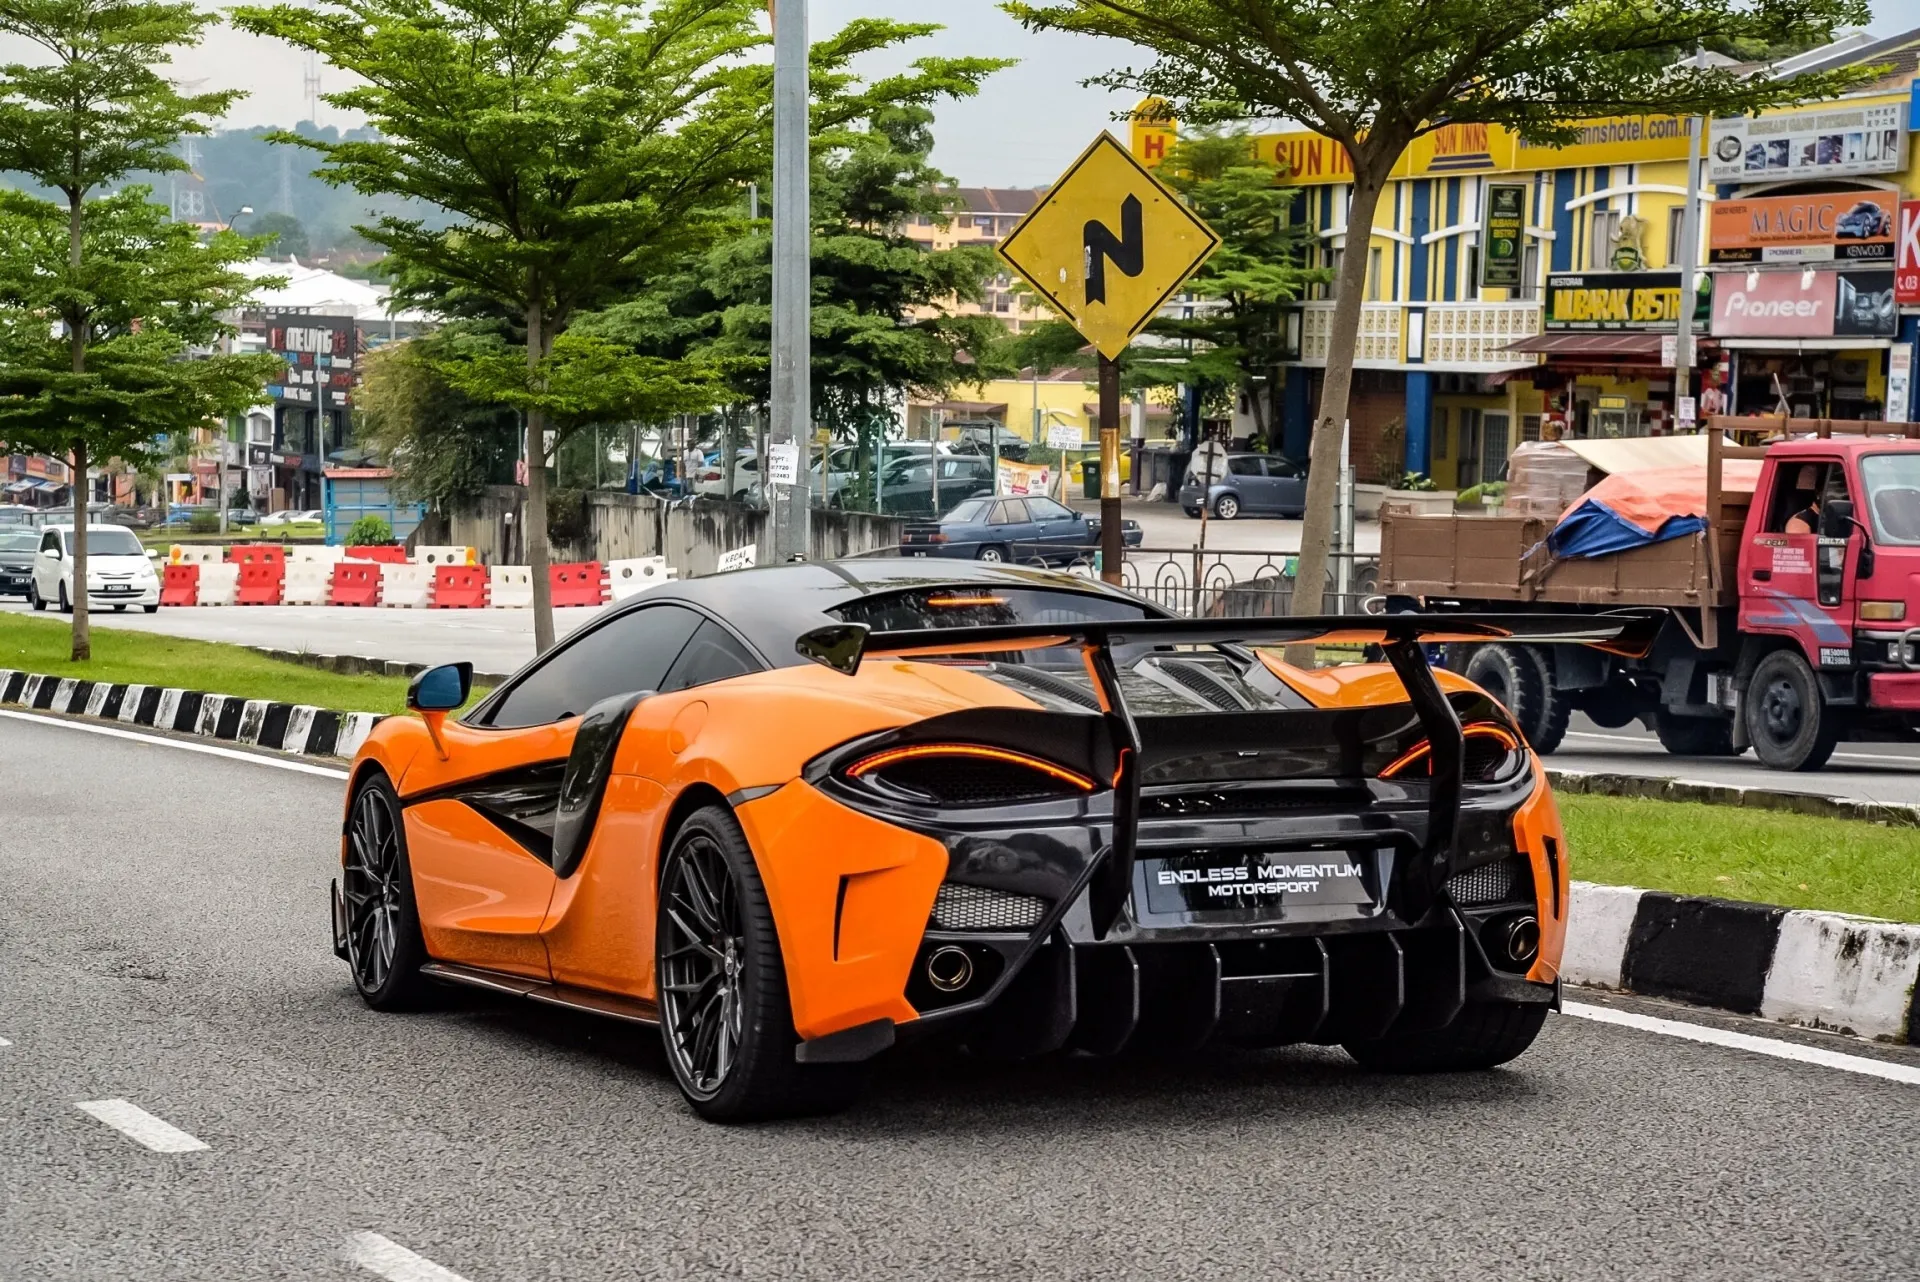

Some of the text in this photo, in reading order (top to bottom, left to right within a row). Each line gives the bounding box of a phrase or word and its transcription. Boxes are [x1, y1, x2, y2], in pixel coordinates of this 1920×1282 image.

[1434, 122, 1488, 153] SUN INNS
[1274, 138, 1323, 179] SUN
[1750, 204, 1834, 234] MAGIC
[1846, 246, 1885, 257] KENWOOD
[1550, 278, 1583, 286] RESTORAN
[1553, 288, 1682, 321] MUBARAK BISTR
[1724, 291, 1822, 317] Pioneer
[1157, 863, 1362, 885] ENDLESS MOMENTUM
[1208, 881, 1320, 897] MOTORSPORT
